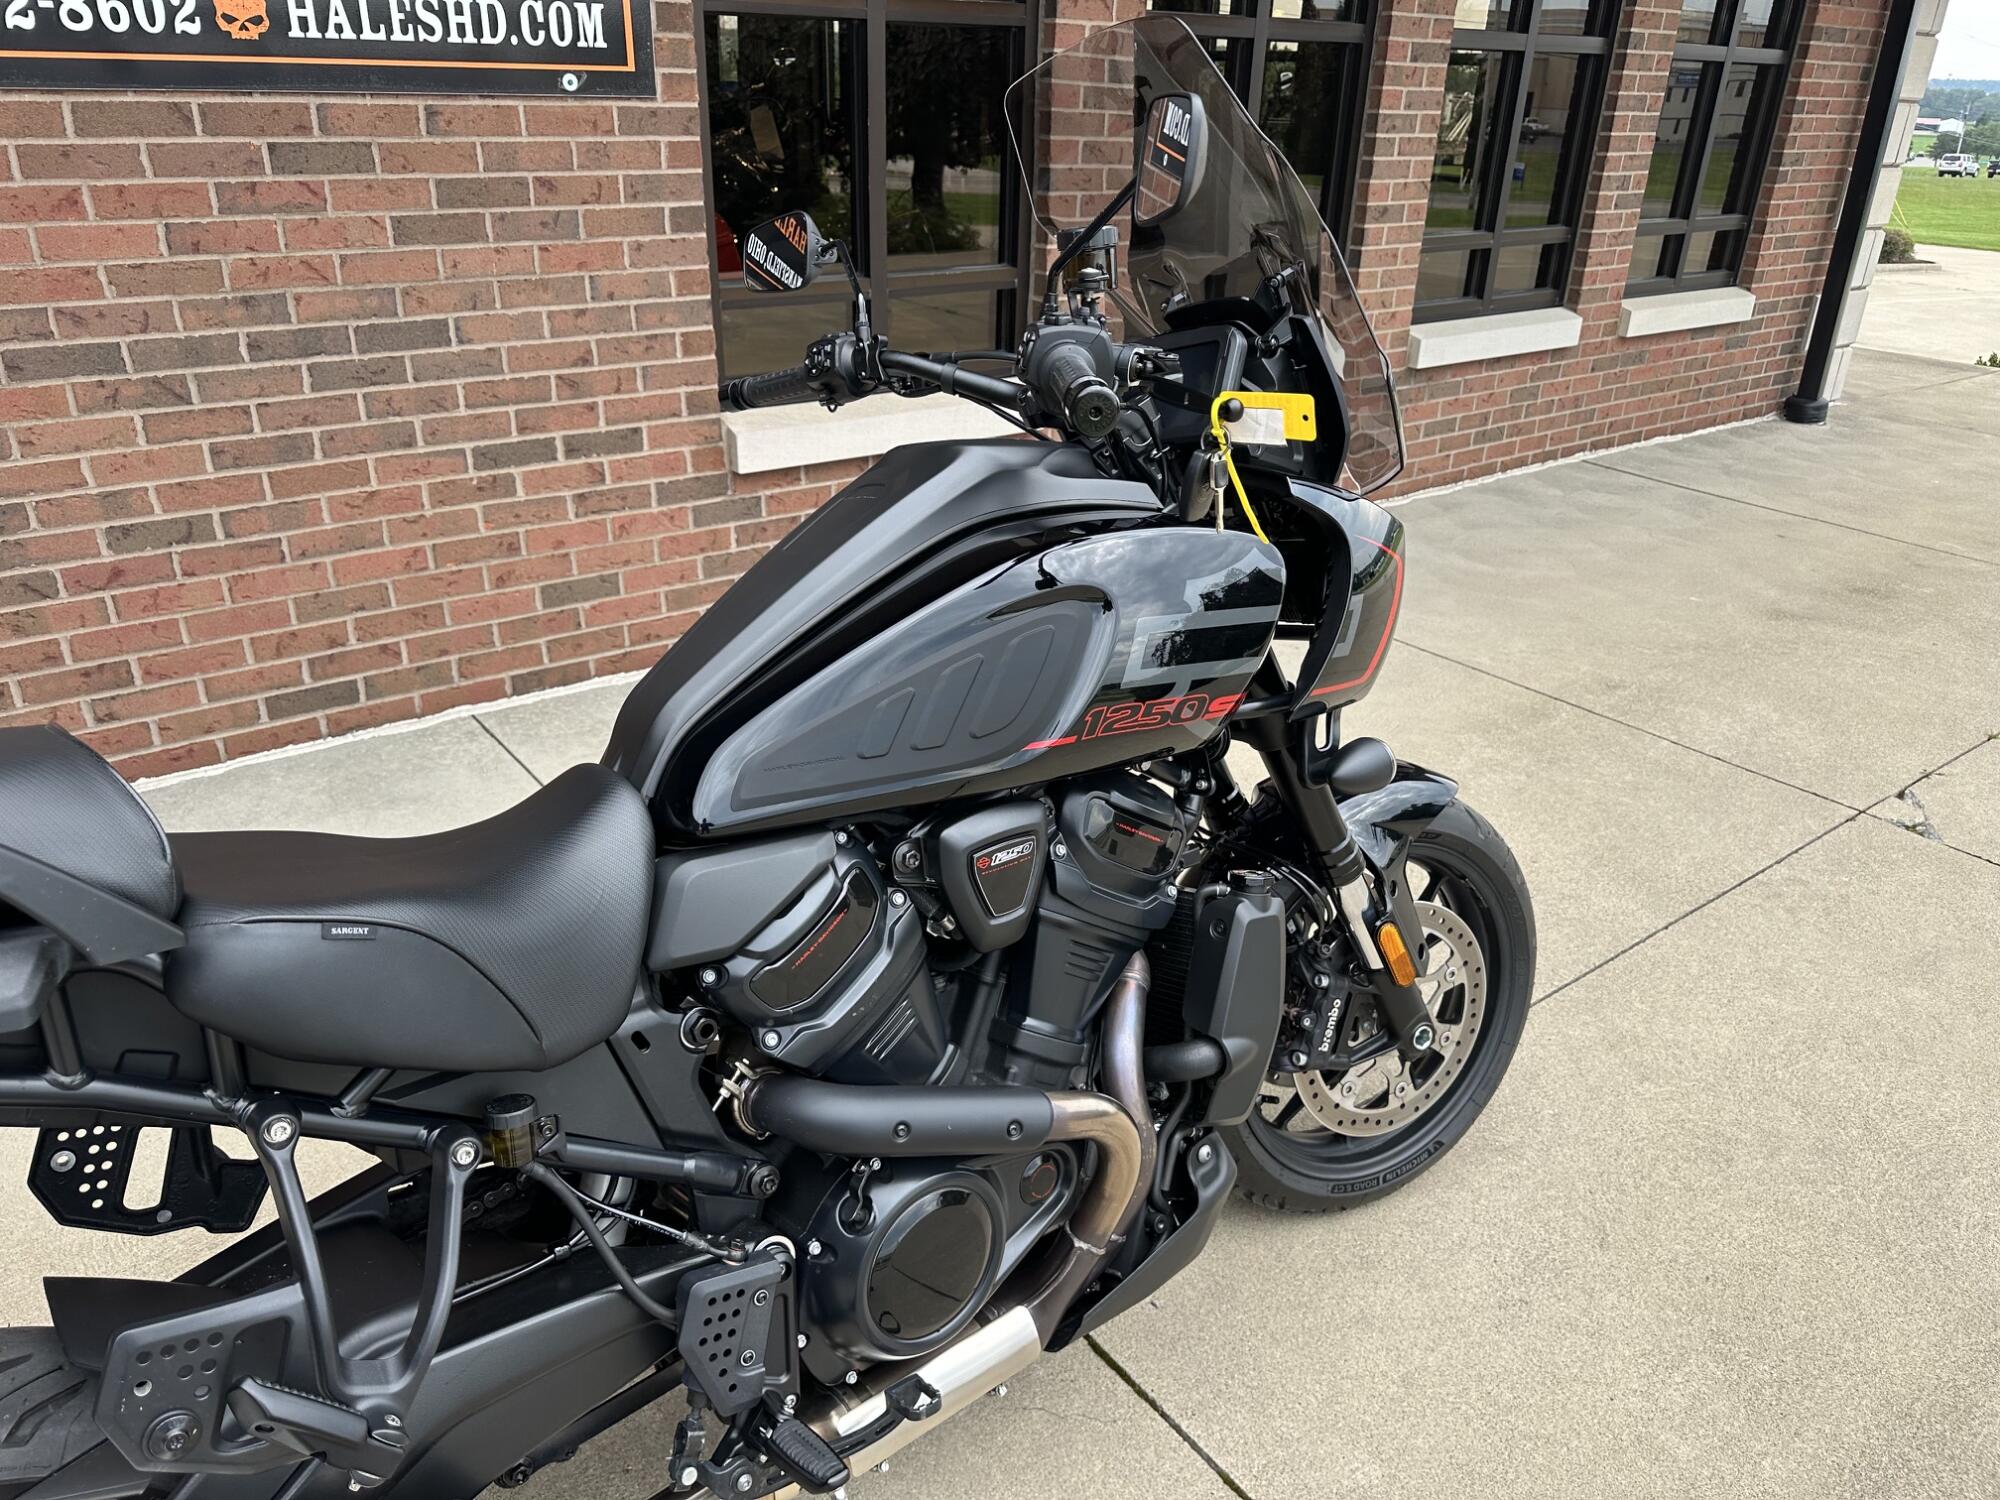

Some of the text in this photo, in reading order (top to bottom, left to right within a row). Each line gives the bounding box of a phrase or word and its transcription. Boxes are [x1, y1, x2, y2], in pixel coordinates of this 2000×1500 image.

[287, 0, 608, 49] HALESHD.COM
[991, 841, 1033, 866] 1250
[331, 927, 369, 935] SARGENT
[1318, 998, 1341, 1052] brembo
[1385, 1151, 1429, 1180] MICHELIN
[1354, 1179, 1378, 1191] ROAD
